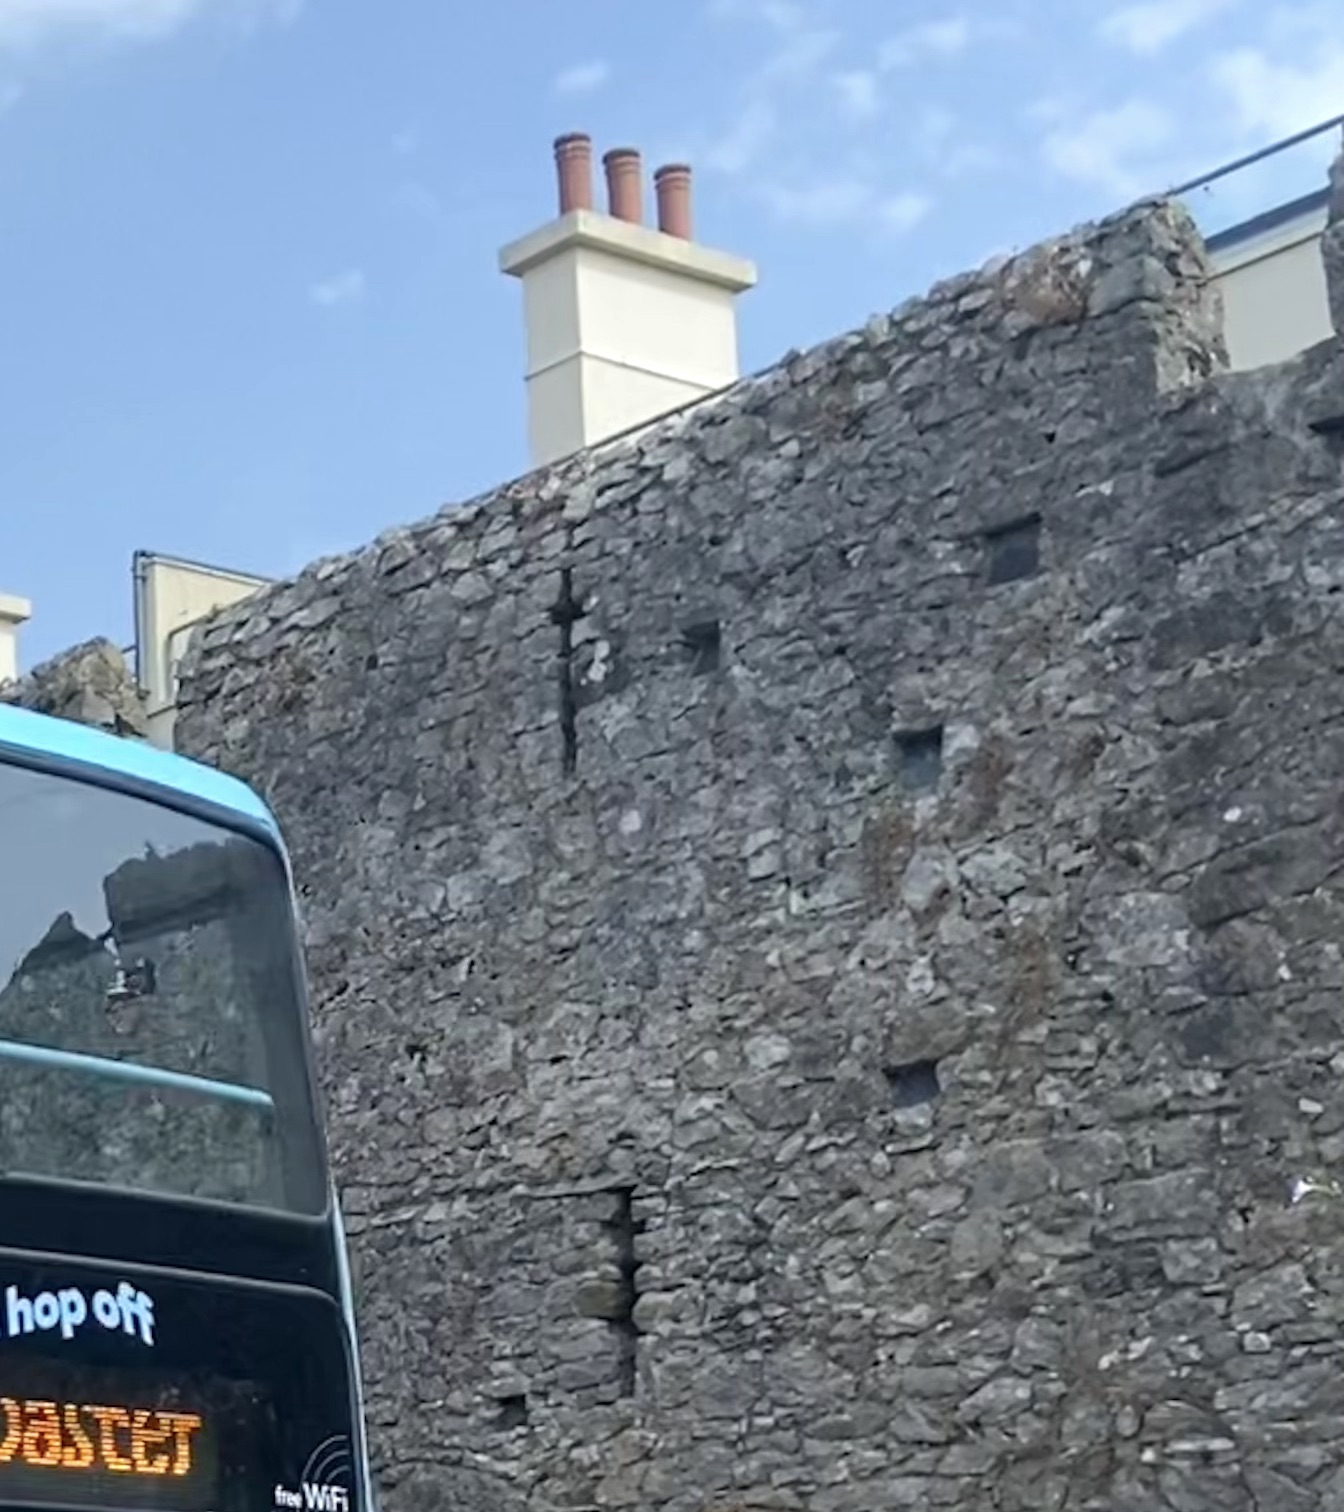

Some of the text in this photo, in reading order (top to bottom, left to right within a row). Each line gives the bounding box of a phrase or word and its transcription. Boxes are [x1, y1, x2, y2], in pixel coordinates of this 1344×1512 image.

[6, 1284, 88, 1339] hop
[94, 1281, 156, 1346] off
[274, 1483, 349, 1512] free WiFi
